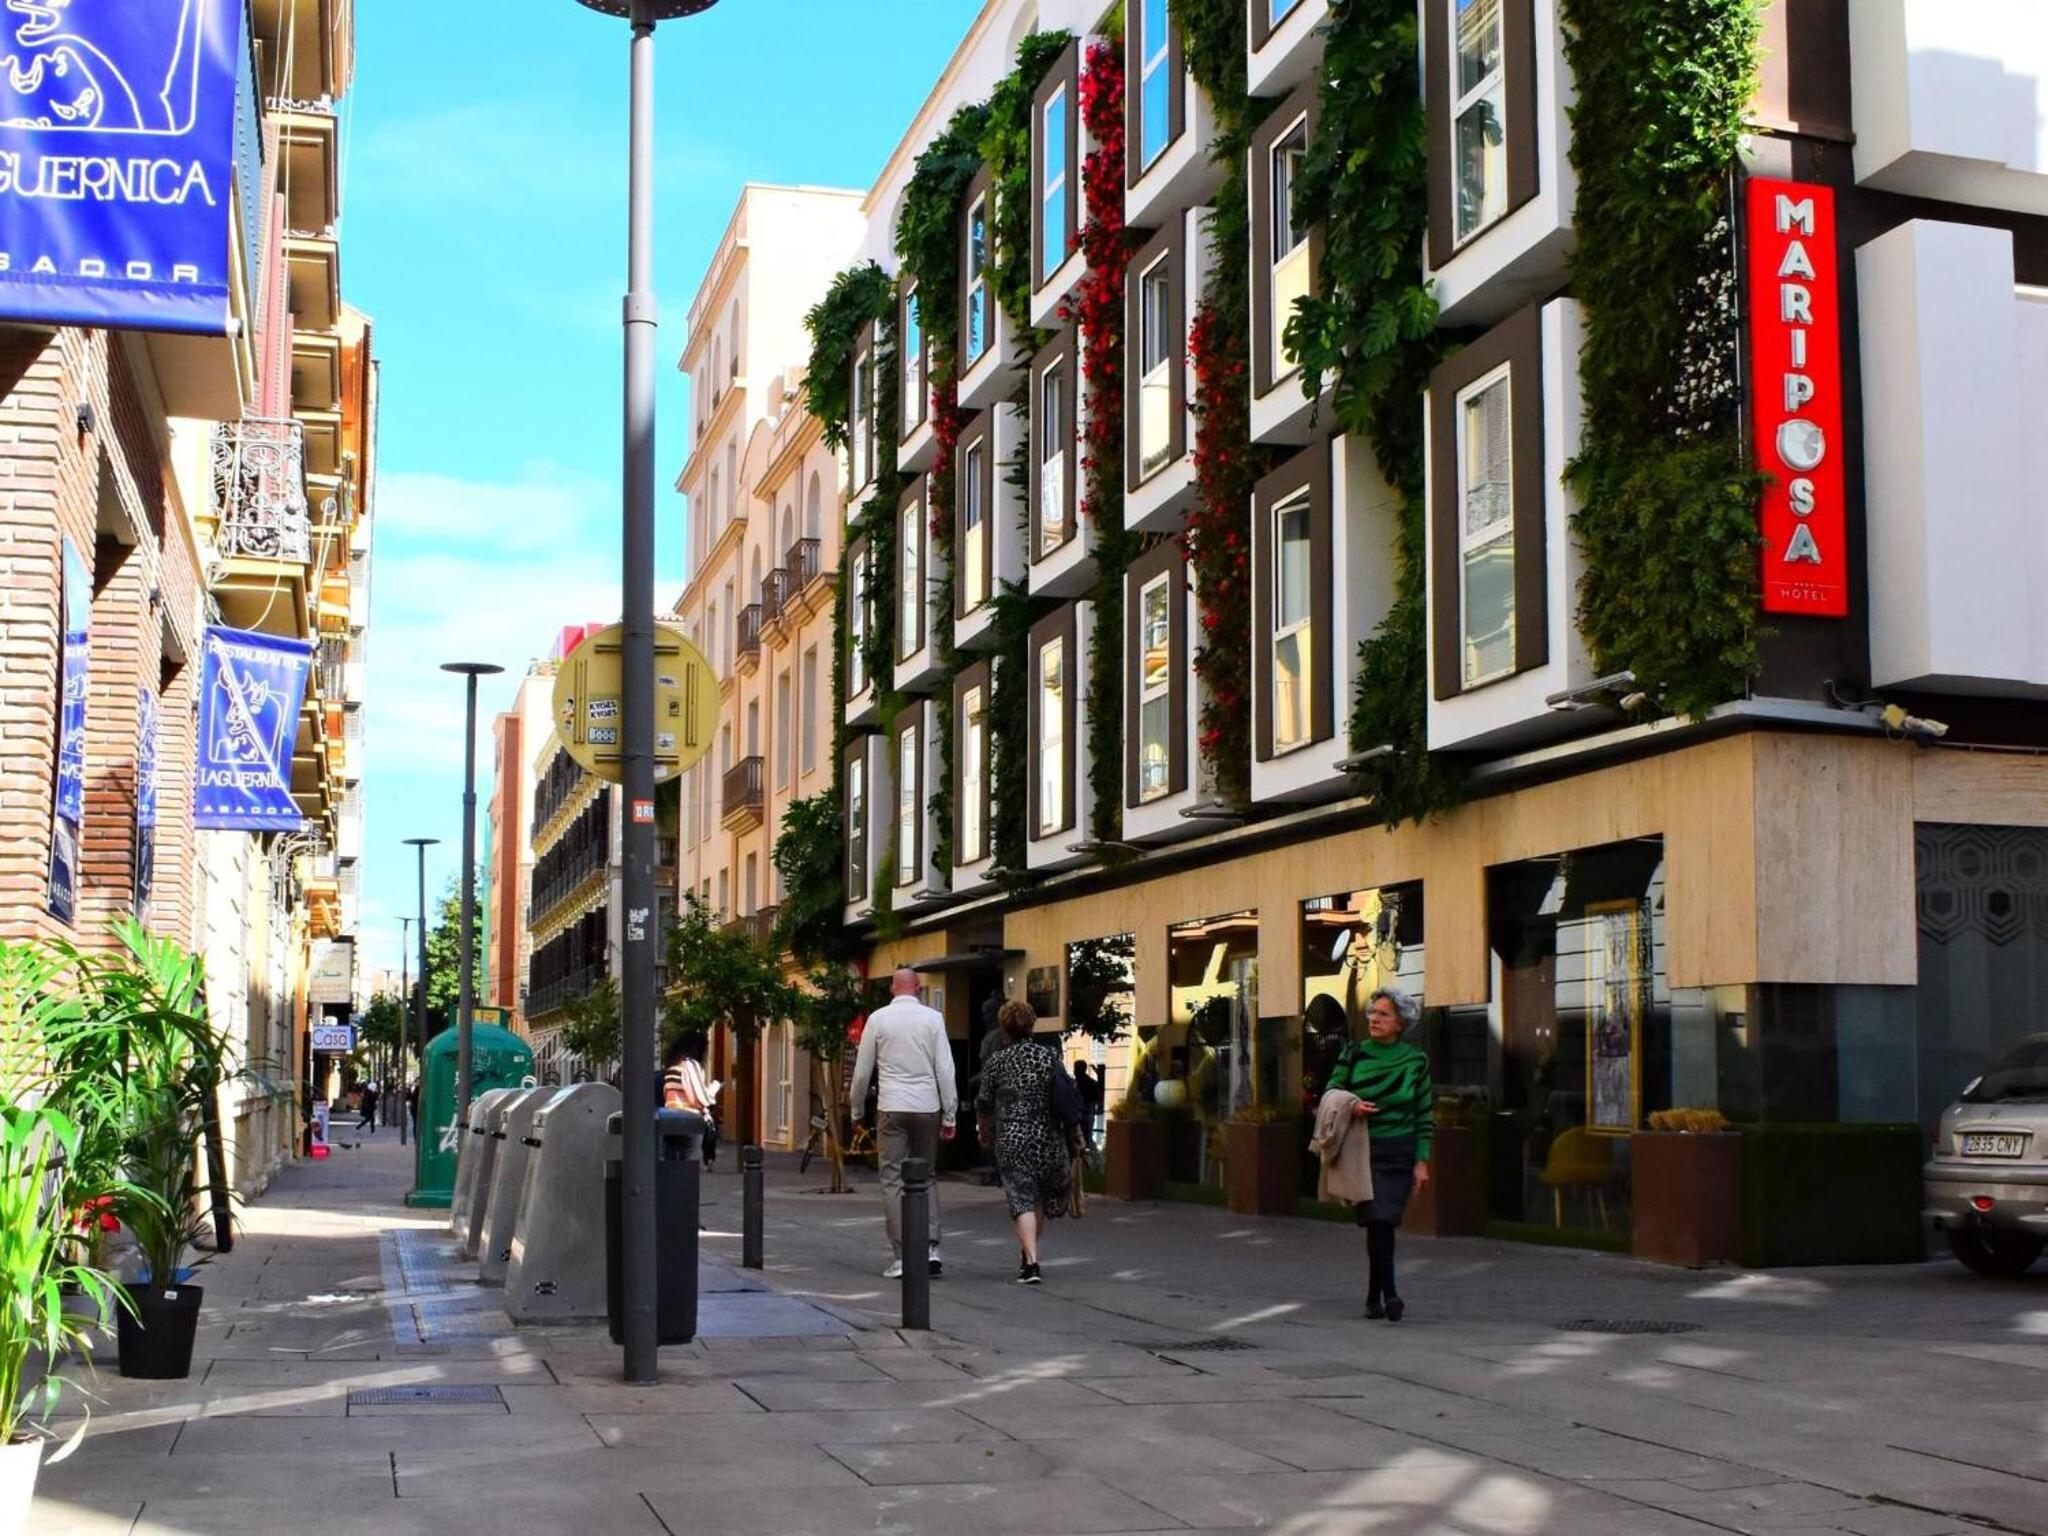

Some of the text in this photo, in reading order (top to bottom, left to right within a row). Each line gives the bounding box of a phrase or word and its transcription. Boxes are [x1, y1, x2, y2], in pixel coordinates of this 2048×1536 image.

[1774, 193, 1826, 566] MARIPOSA
[1780, 588, 1828, 602] HOTEL
[313, 1028, 348, 1046] Casa
[1968, 1136, 2020, 1153] 2835 CNY
